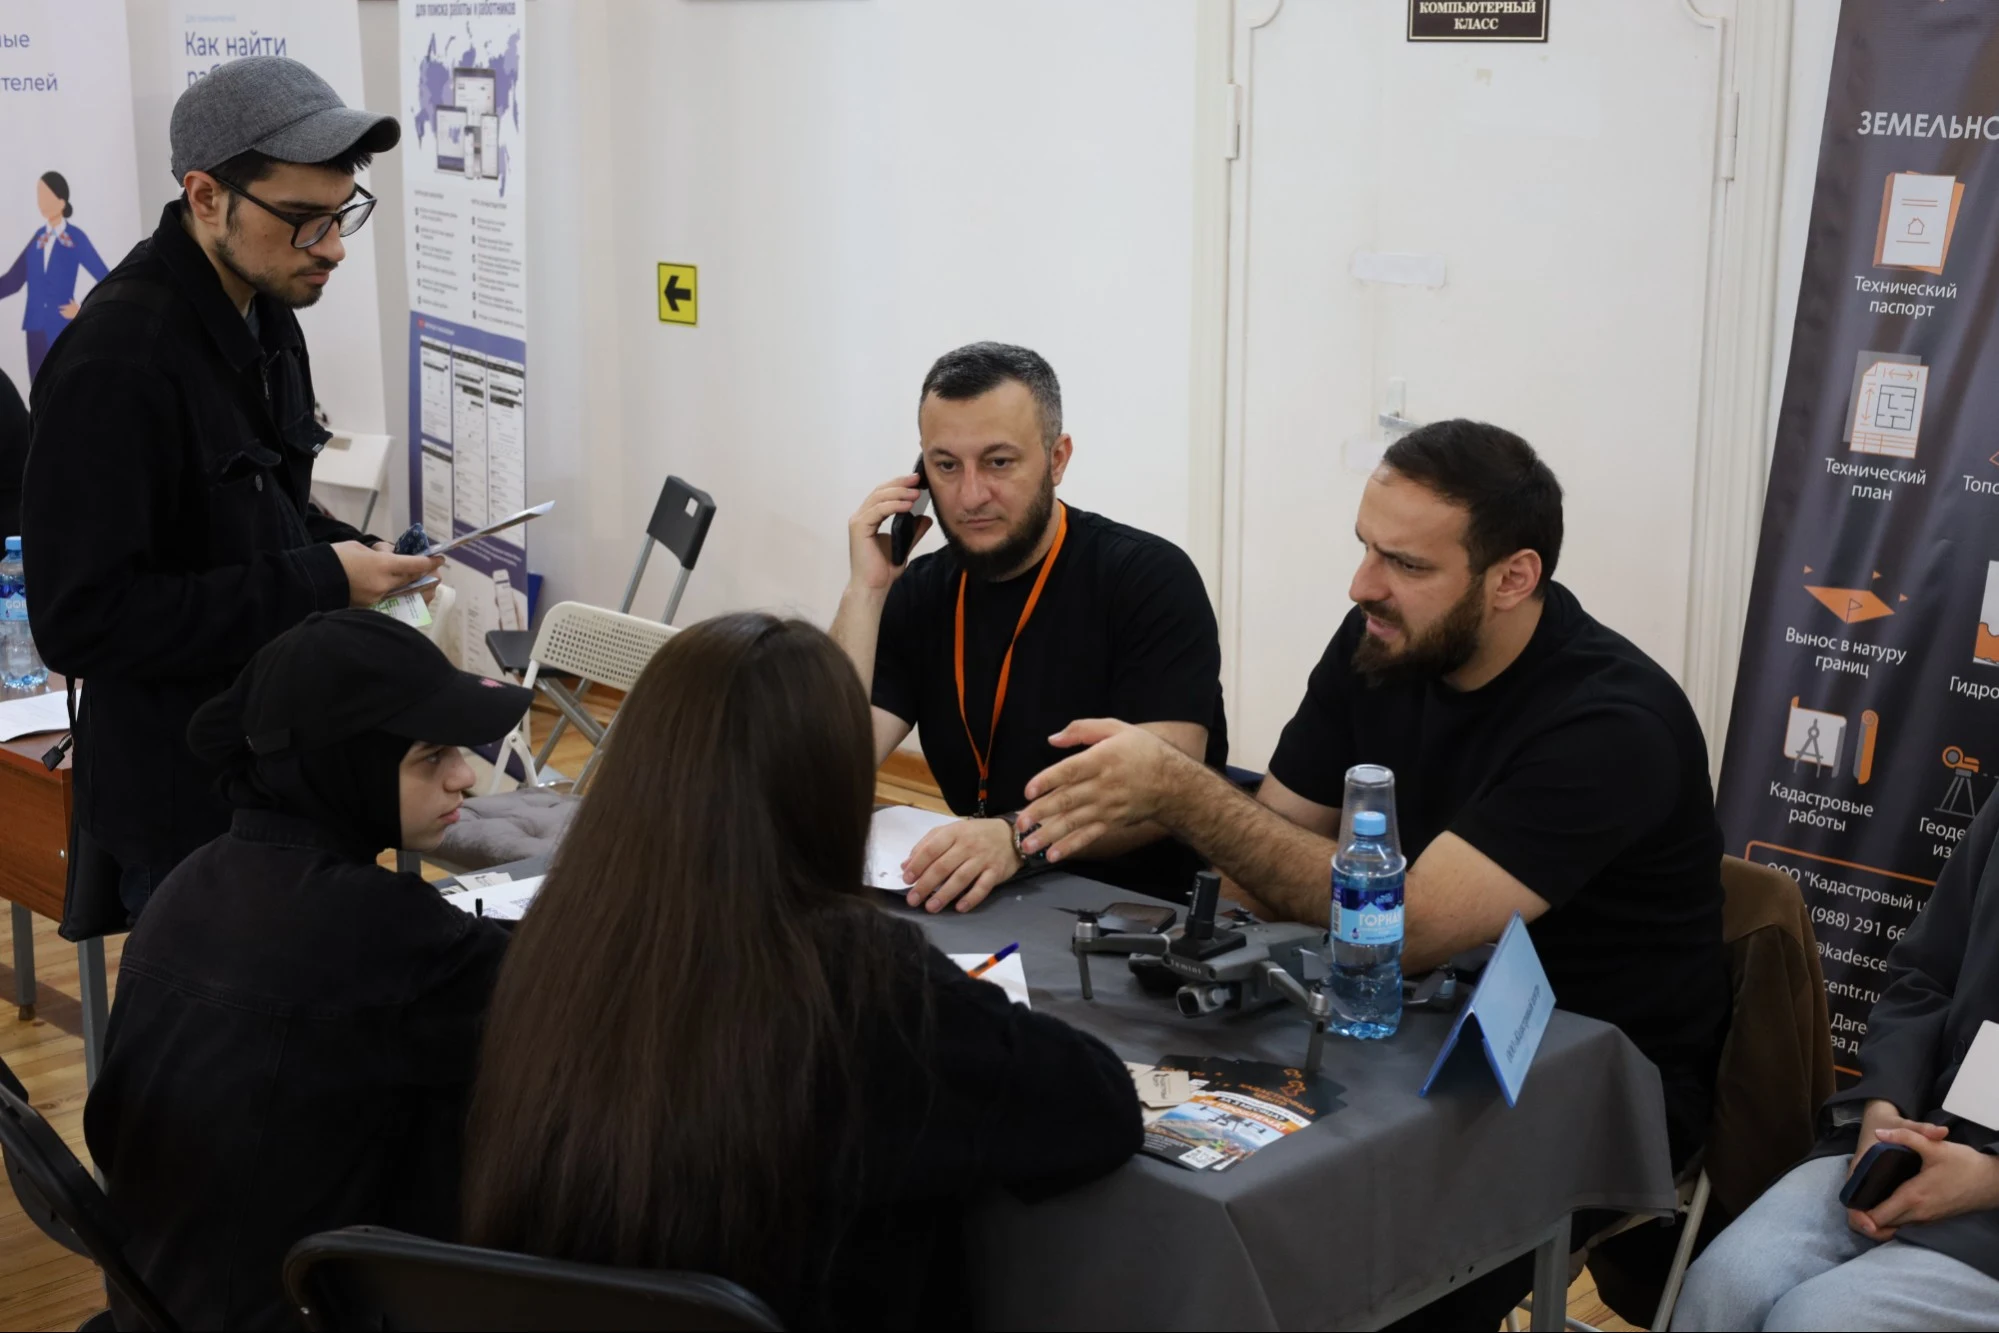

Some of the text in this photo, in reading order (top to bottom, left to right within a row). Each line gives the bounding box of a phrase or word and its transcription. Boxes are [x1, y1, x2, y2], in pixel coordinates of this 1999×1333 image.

[1419, 0, 1536, 14] КОМПЬЮТЕРНЫЙ
[1454, 18, 1499, 30] КЛАСС
[0, 33, 30, 48] ые
[185, 29, 287, 57] Как найти
[0, 72, 58, 92] телей
[1854, 275, 1957, 299] Технический
[1869, 300, 1935, 320] паспорт
[1825, 457, 1927, 486] Технический
[1851, 484, 1893, 501] план
[1785, 626, 1907, 666] Вынос в натуру
[1815, 654, 1870, 679] границ
[1950, 675, 1999, 701] Гидро
[1769, 780, 1874, 817] Кадастровые
[1788, 807, 1846, 832] работы
[1919, 816, 1966, 843] Геоде
[1932, 844, 1952, 859] из
[1804, 870, 1913, 911] "Кадастровый
[1811, 905, 1850, 931] (988)
[1853, 916, 1881, 937] 291
[1830, 1012, 1868, 1035] Даге
